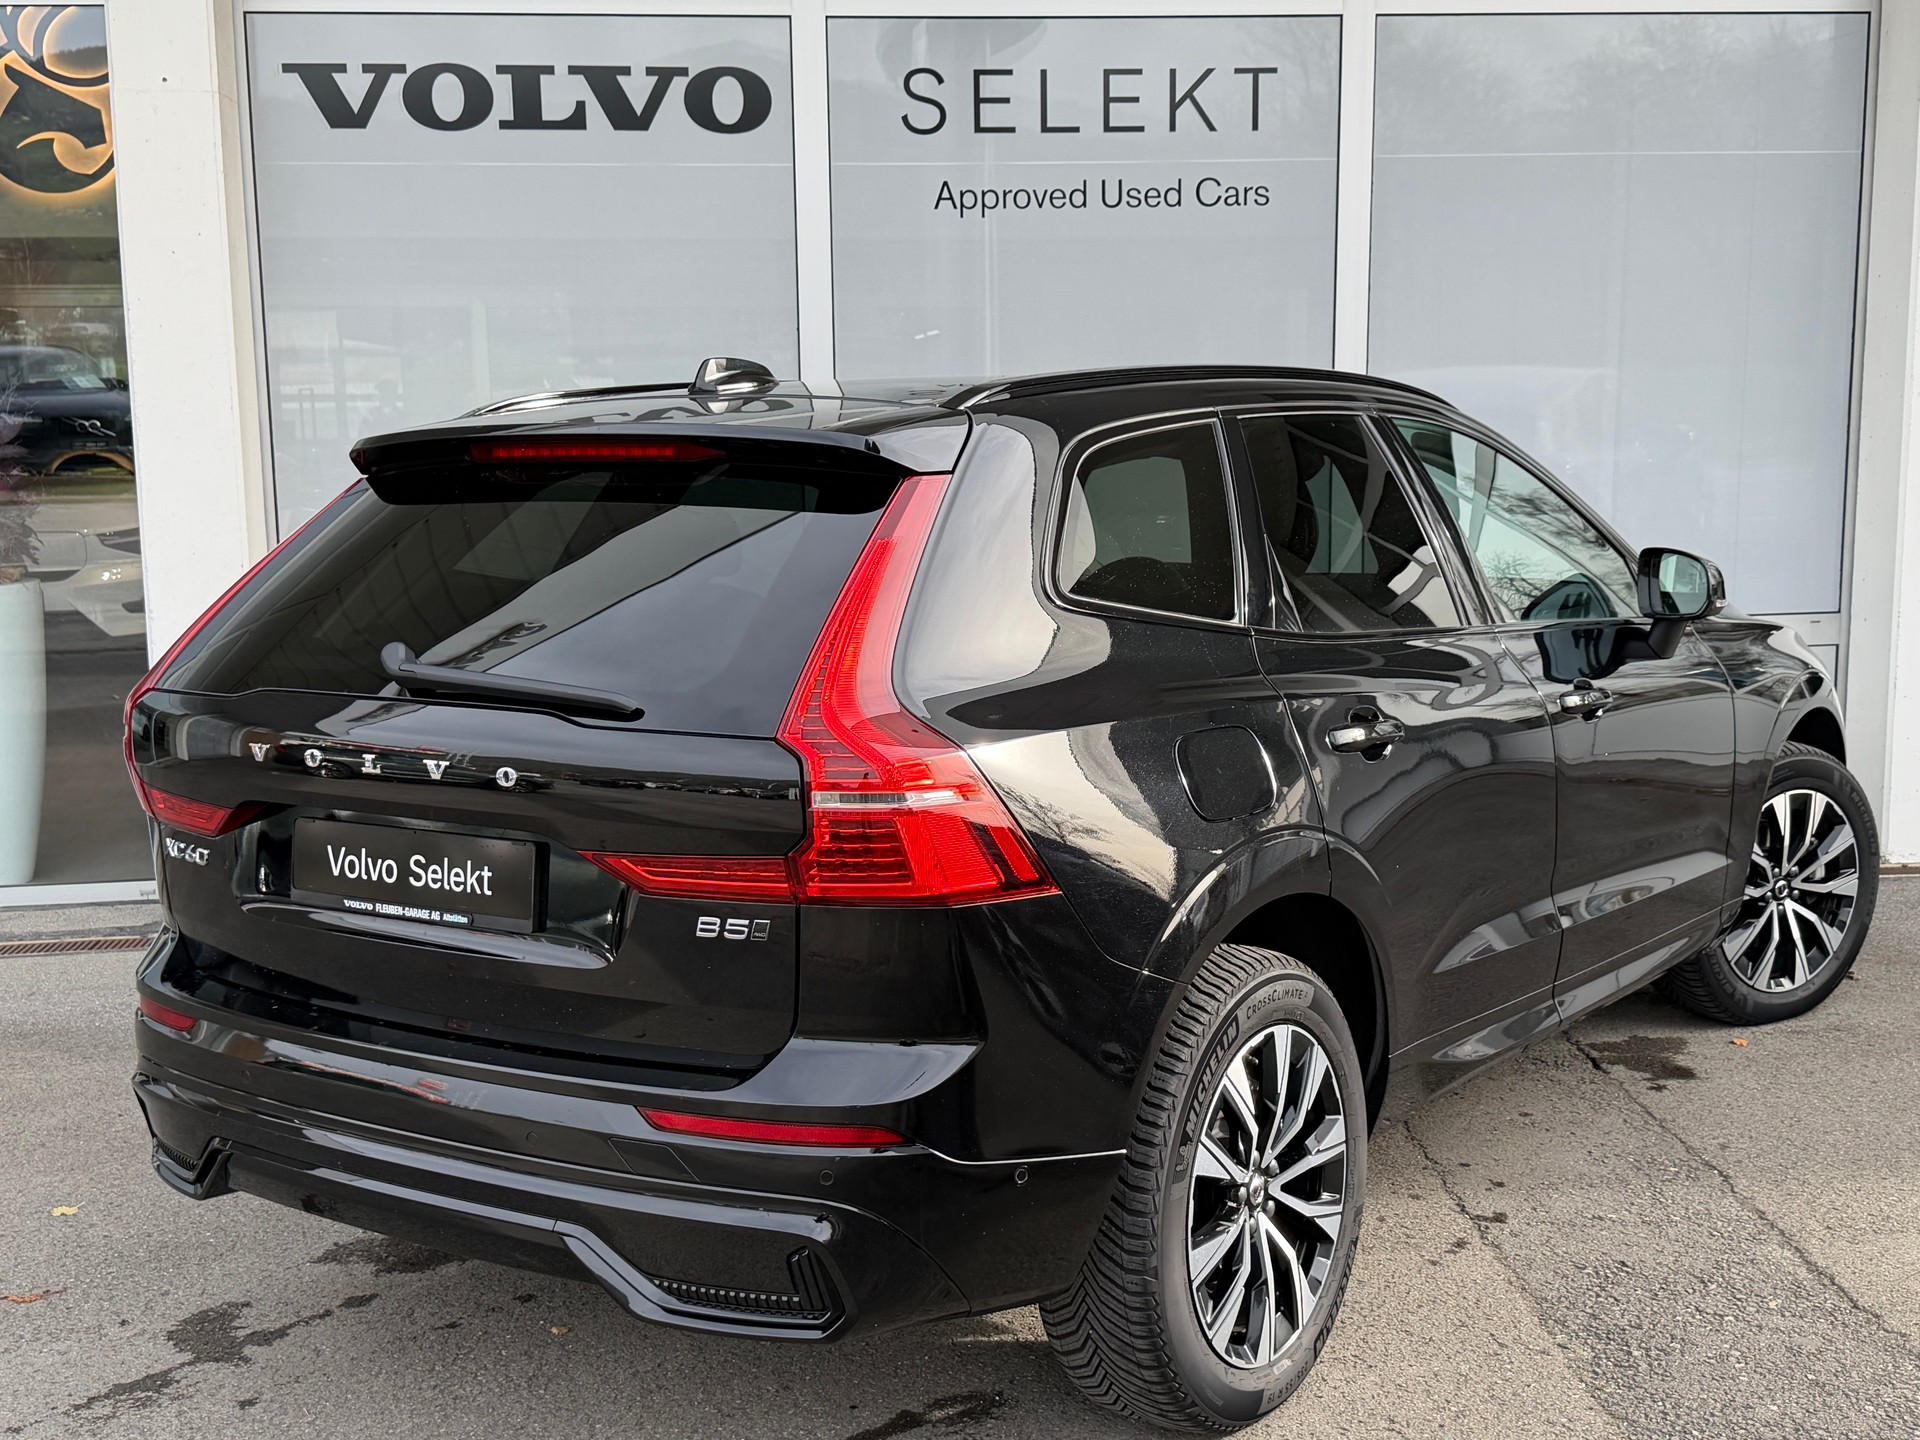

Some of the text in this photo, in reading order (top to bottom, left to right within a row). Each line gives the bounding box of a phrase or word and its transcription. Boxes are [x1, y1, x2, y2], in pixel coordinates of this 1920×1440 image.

[282, 63, 773, 135] VOLVO
[902, 67, 1278, 136] SELEKT
[934, 177, 1270, 219] Approved Used Cars
[248, 742, 518, 788] VOLVO
[165, 837, 210, 866] XC60
[326, 844, 493, 896] Volvo Selekt
[343, 899, 374, 911] VOLVO
[375, 903, 431, 919] FLEUBEN-GARAGE
[431, 910, 441, 921] AG
[696, 916, 750, 940] B5
[1185, 1020, 1238, 1139] MICHELIN
[1284, 1360, 1309, 1393] 235/55
[1267, 1391, 1277, 1405] 19
